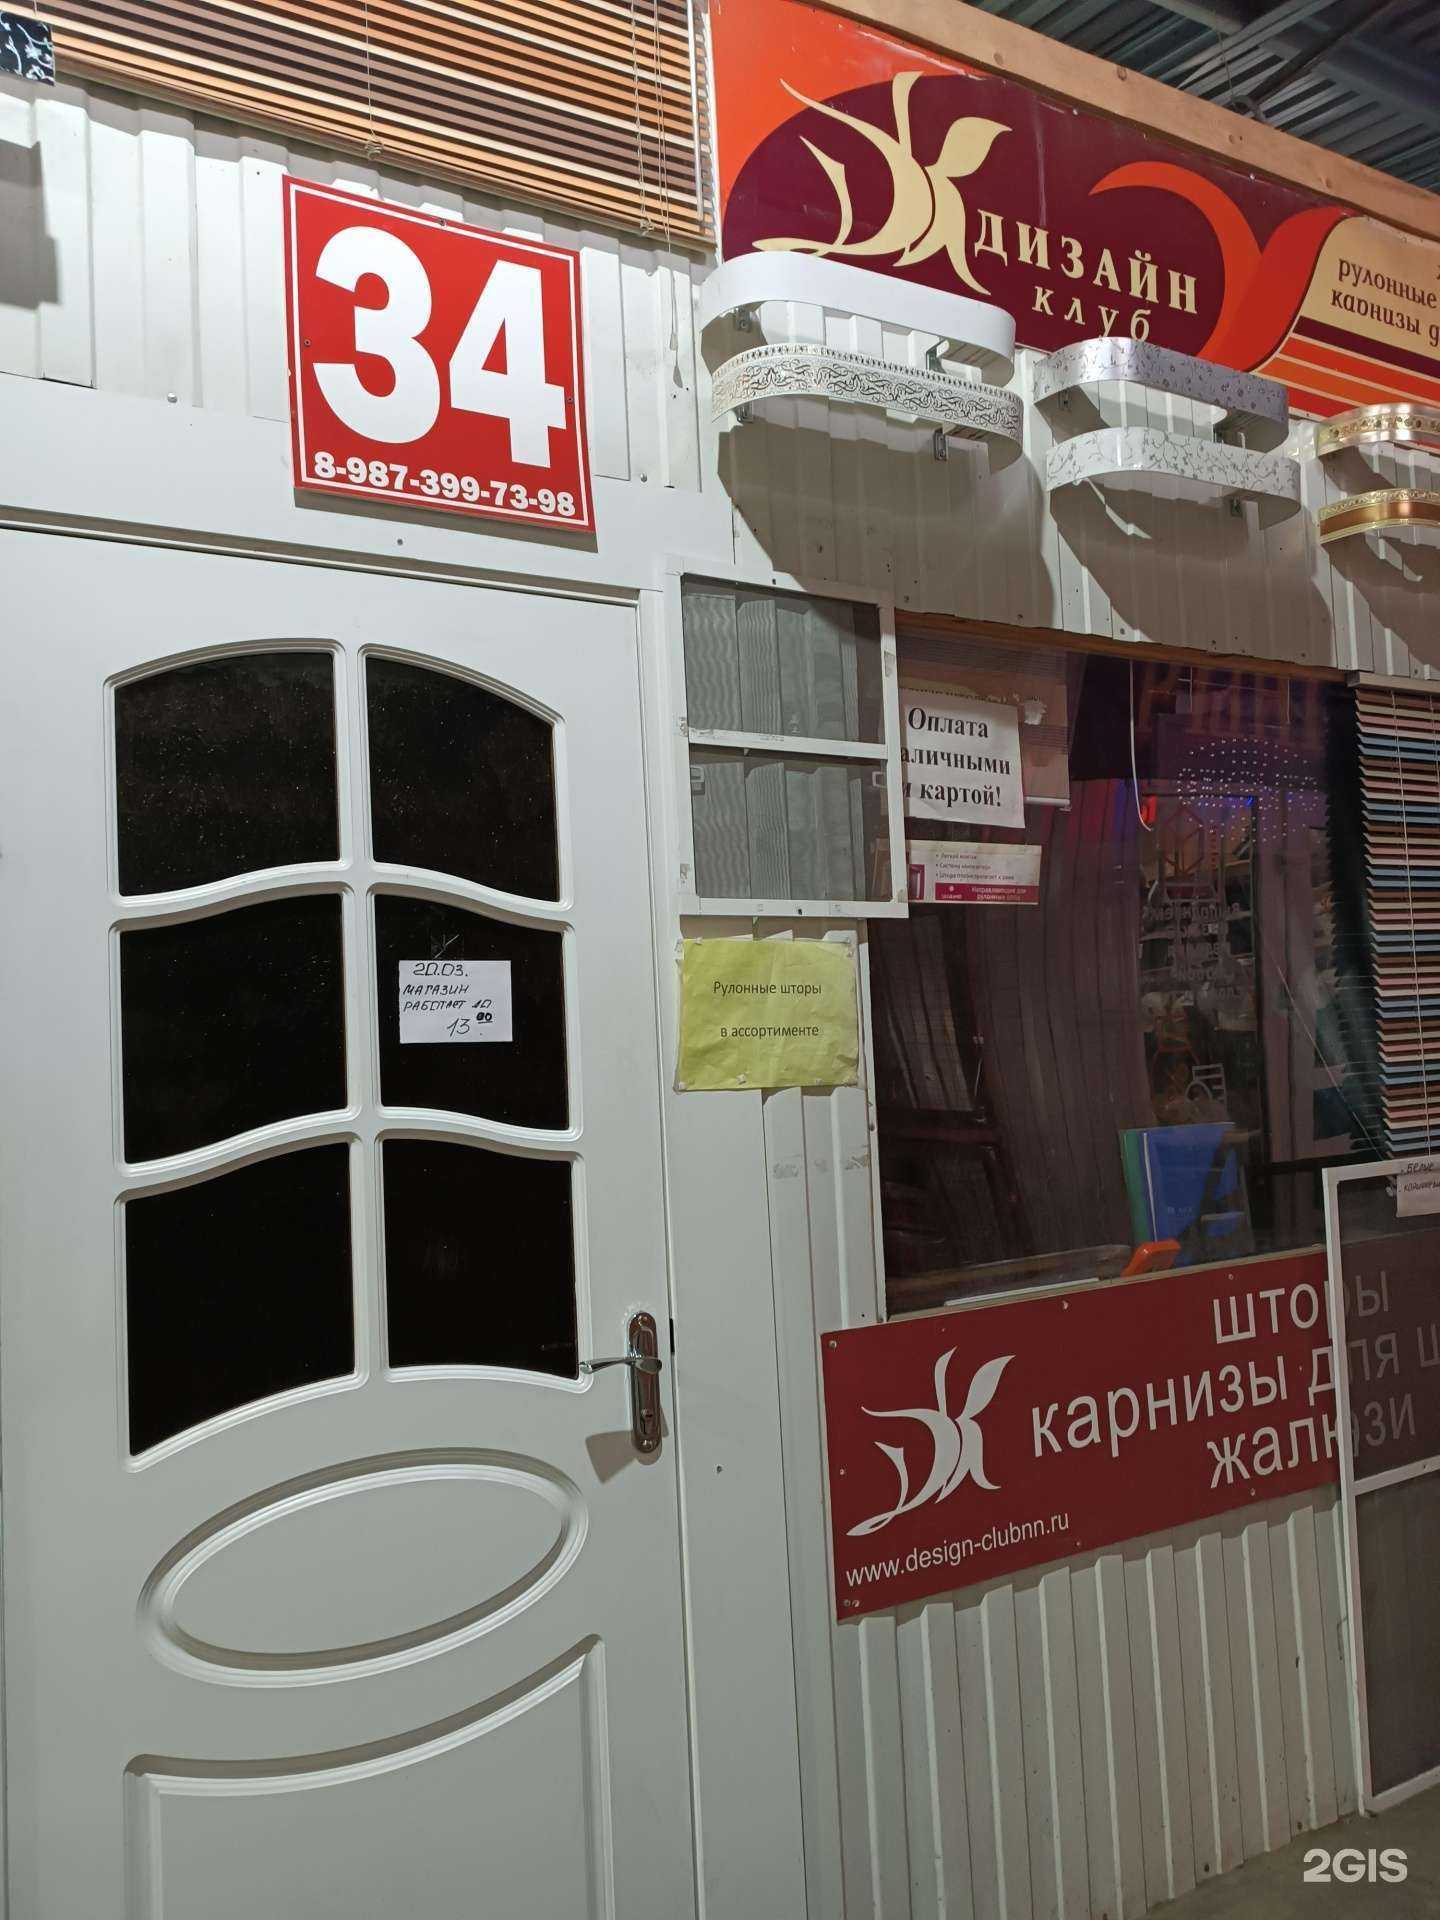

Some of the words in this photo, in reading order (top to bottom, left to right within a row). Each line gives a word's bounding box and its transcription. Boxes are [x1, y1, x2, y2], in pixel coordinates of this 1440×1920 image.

[974, 208, 1198, 314] ДИЗАЙН
[1338, 257, 1438, 309] рулонные
[312, 226, 567, 469] 34
[313, 450, 576, 517] 8-987-399-73-98
[908, 706, 989, 739] Оплата
[900, 745, 1011, 776] аличными
[919, 781, 1002, 808] картой!
[402, 983, 470, 996] МАГАЗИН
[713, 980, 777, 997] Рулонные
[780, 982, 823, 997] шторы
[720, 1027, 727, 1038] в
[731, 1025, 819, 1039] ассортименте
[1031, 1355, 1288, 1458] карнизы
[845, 1512, 1070, 1587] www.design-clubnn.ru
